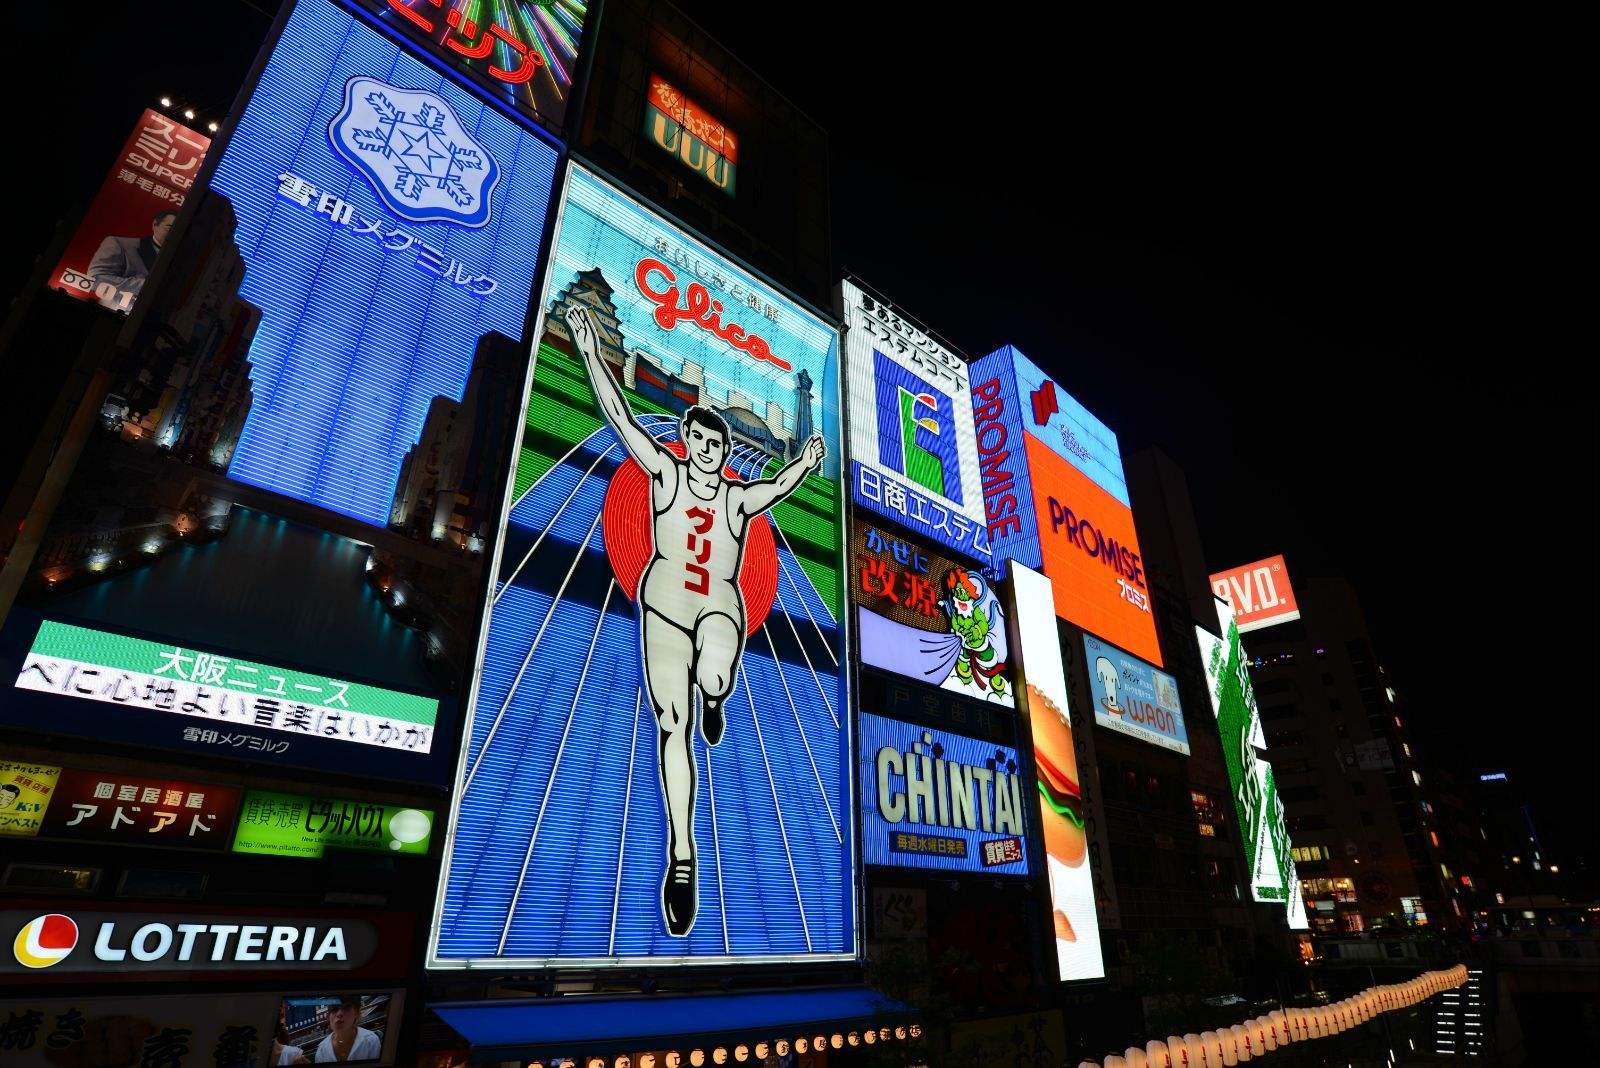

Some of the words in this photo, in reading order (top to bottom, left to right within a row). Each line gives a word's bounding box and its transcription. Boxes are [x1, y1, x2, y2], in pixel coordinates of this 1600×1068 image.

[136, 133, 200, 174] ミリ
[143, 114, 206, 152] スー
[277, 170, 498, 295] 雪印メグミルク
[863, 315, 965, 393] エステムコート
[971, 376, 1022, 544] PROMISE
[684, 505, 716, 597] グリコ
[1047, 494, 1146, 590] PROMISE
[857, 555, 939, 618] 改源
[1116, 578, 1151, 613] プロミス
[153, 647, 350, 707] 大阪ニュース
[183, 725, 290, 754] 雪印メグミルク
[66, 803, 216, 837] アドアド
[93, 782, 205, 808] 個室居酒屋
[877, 745, 1024, 837] CHINTAI
[94, 922, 347, 962] LOTTERIA
